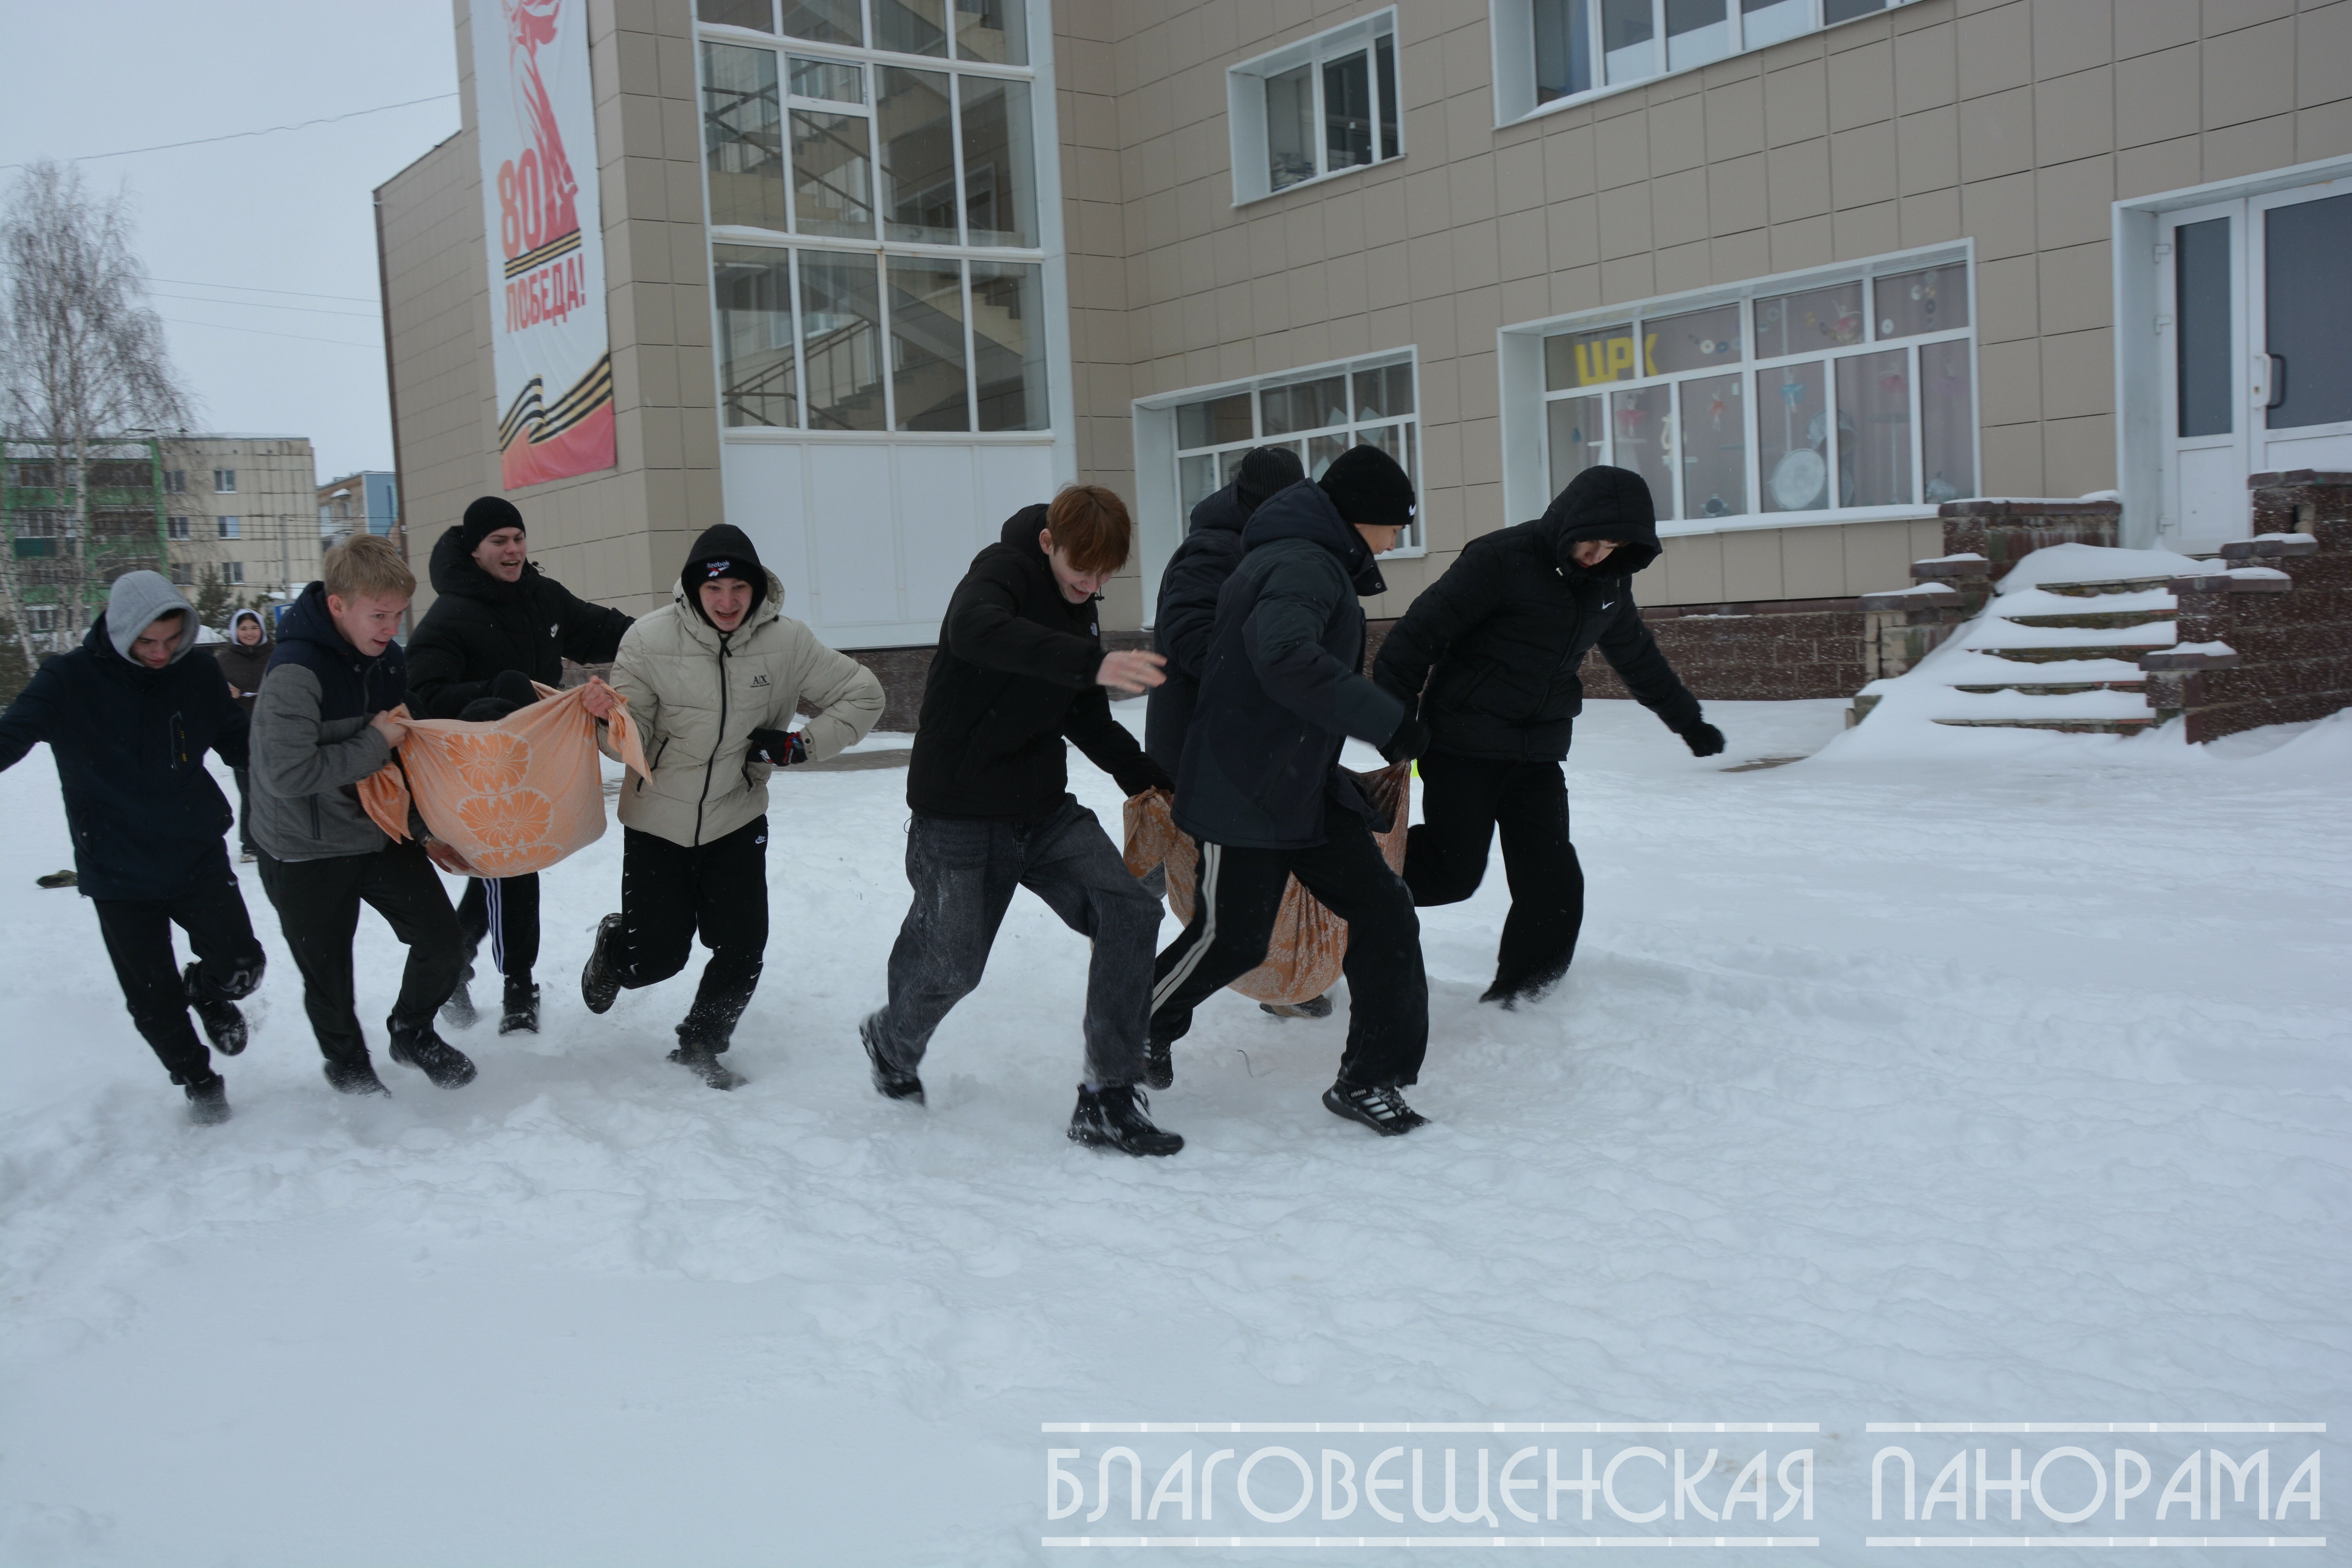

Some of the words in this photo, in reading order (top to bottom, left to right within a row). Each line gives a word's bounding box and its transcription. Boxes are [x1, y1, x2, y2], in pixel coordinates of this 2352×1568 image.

[497, 147, 541, 260] 80
[505, 253, 586, 333] ПОБЕДА!
[706, 560, 730, 568] Reebok
